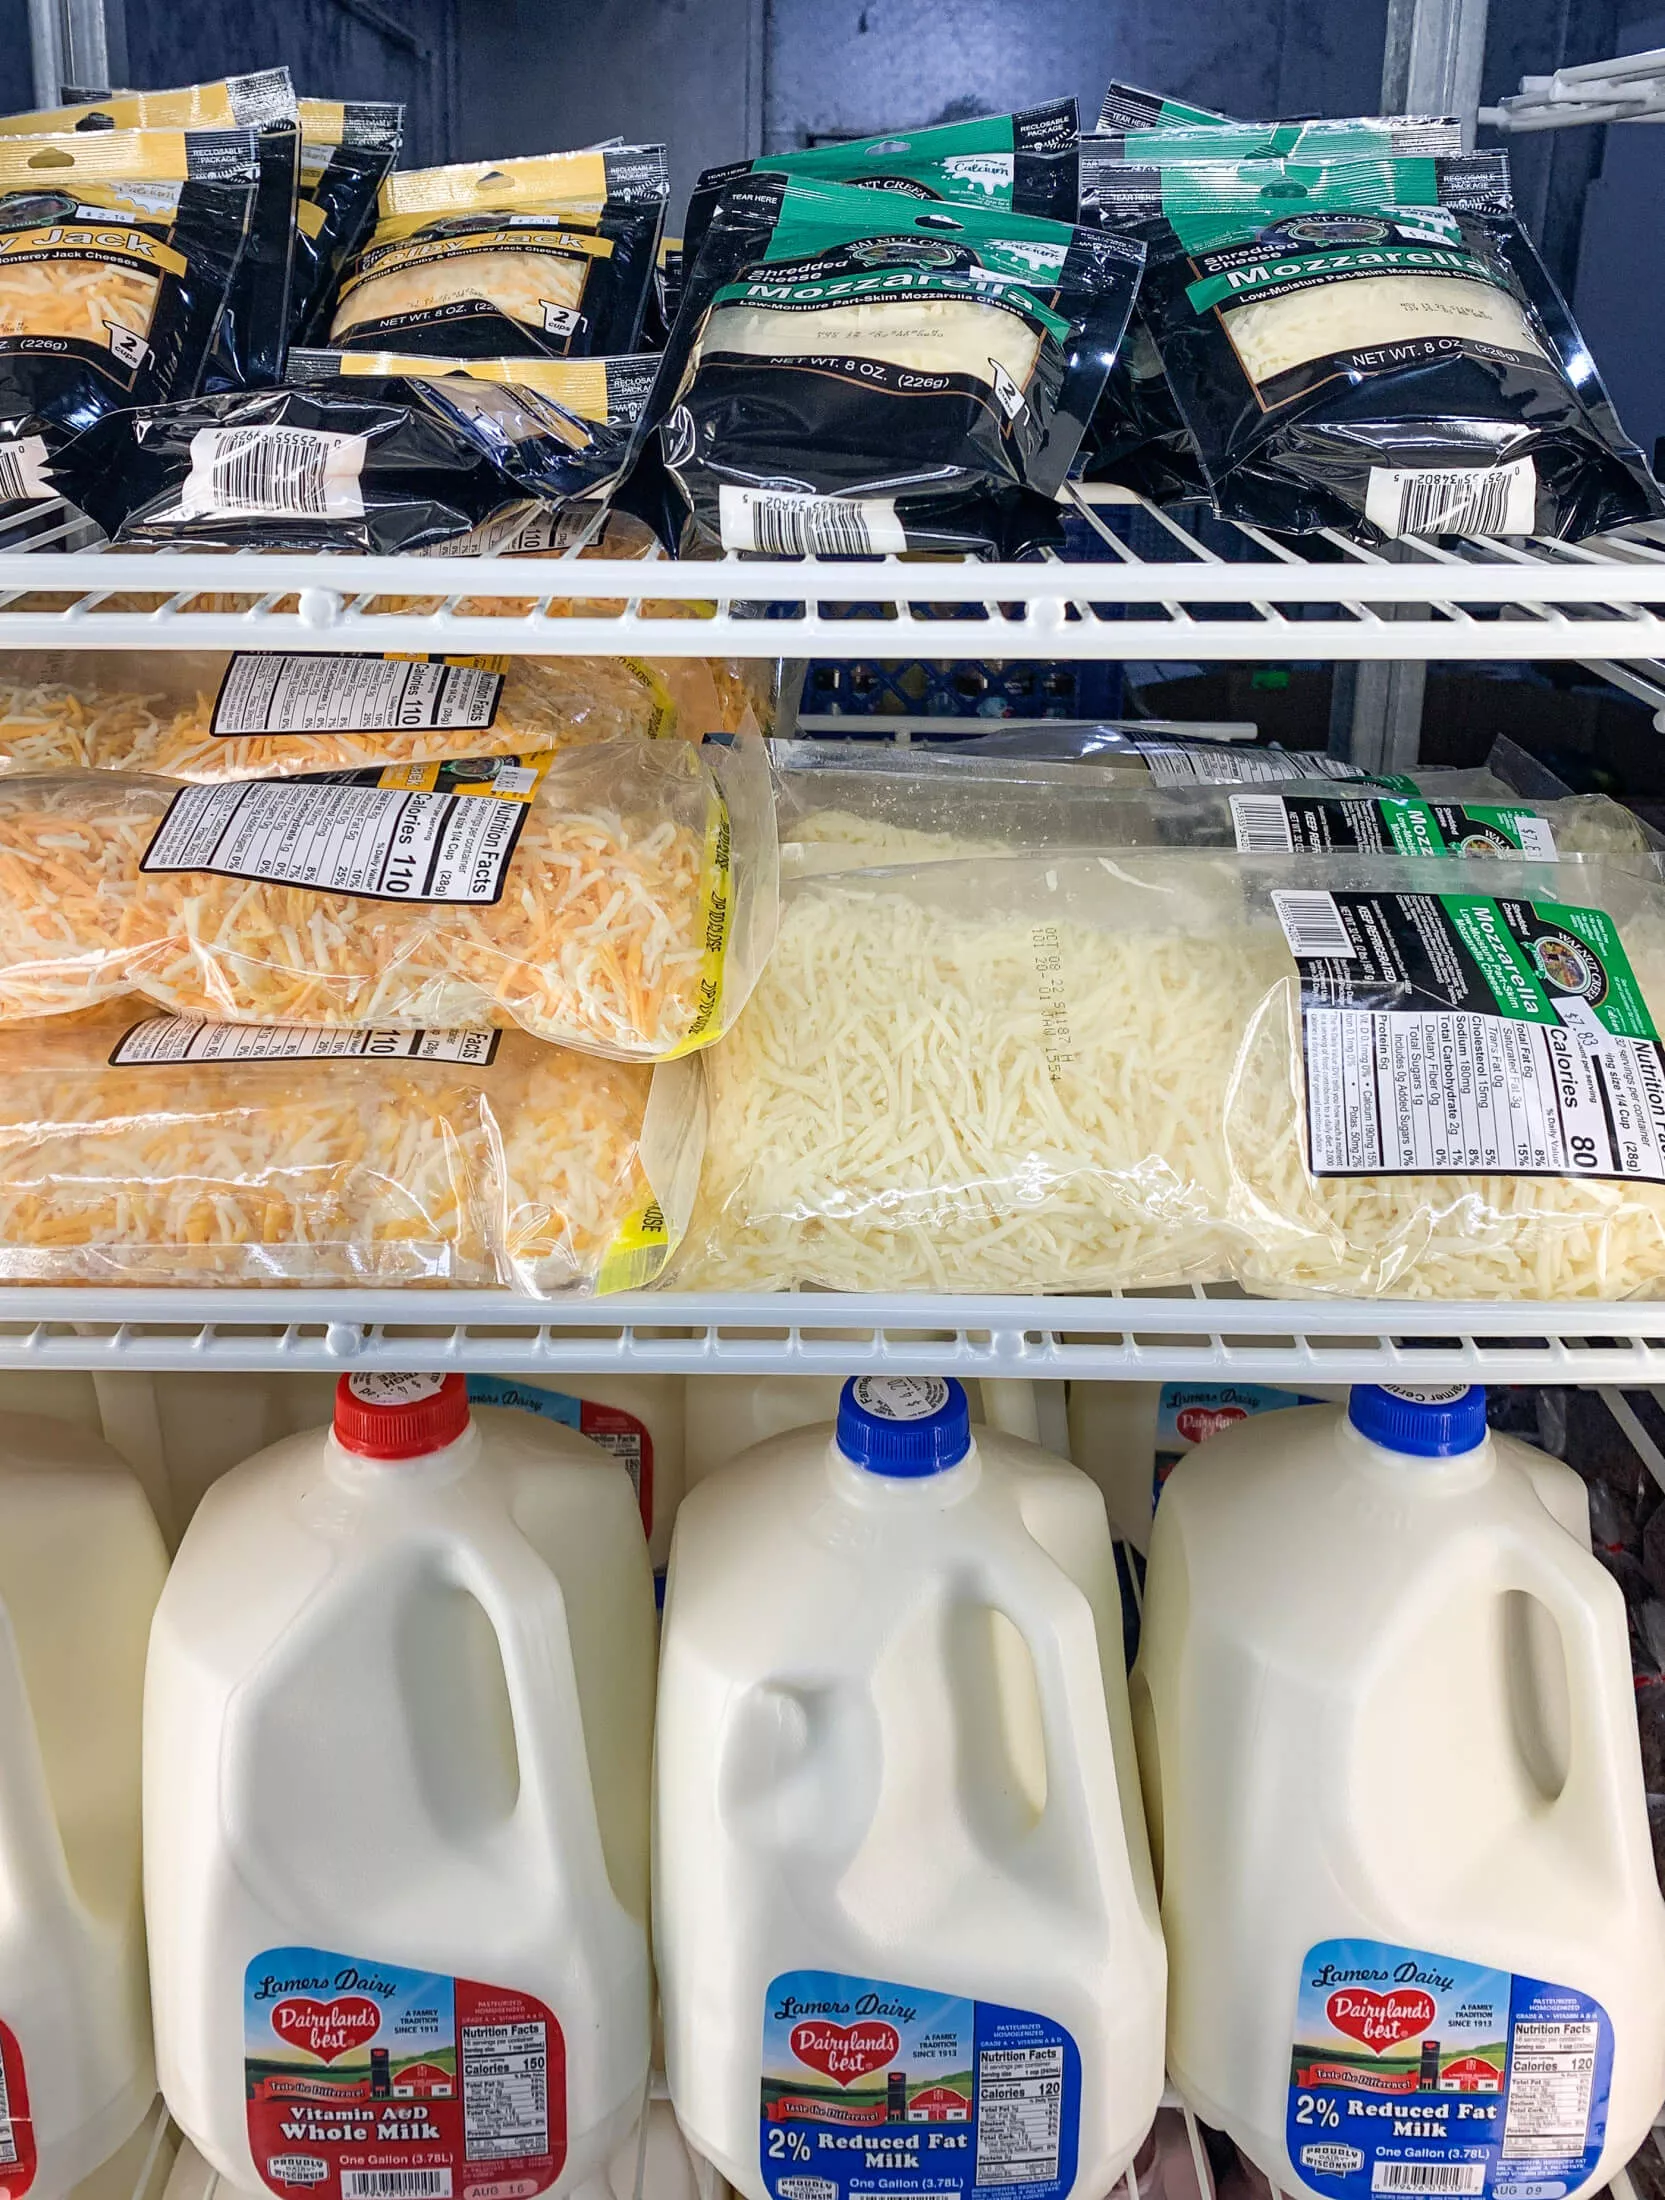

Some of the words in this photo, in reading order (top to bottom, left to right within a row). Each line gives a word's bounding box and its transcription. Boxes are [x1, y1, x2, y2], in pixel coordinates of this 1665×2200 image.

[1020, 115, 1070, 133] RECLOSABLE
[1027, 124, 1064, 137] PACKAGE
[954, 162, 1009, 177] Calcium
[732, 193, 753, 202] TEAR
[755, 195, 778, 204] HERE
[883, 180, 931, 199] CREEK
[32, 229, 157, 257] Jack
[482, 232, 585, 248] Jack
[85, 252, 138, 267] Cheeses
[404, 255, 433, 268] Colby
[446, 246, 495, 258] Monterey
[525, 246, 569, 257] Cheeses
[1204, 242, 1299, 266] Shredded
[1208, 252, 1282, 272] Cheese
[747, 272, 821, 284] Cheese
[751, 260, 848, 278] Shredded
[1226, 251, 1488, 289] Mozzarella
[746, 271, 1034, 311] Mozzarella
[1239, 277, 1325, 303] Low-Moisture
[1326, 267, 1386, 282] Part-Skim
[379, 317, 406, 328] NET
[409, 311, 430, 323] WT.
[435, 309, 443, 317] 8
[446, 304, 467, 315] OZ.
[739, 299, 829, 311] Low-Moisture
[832, 293, 897, 307] Part-Skim
[901, 292, 973, 301] Mozzarella
[976, 295, 1024, 317] Cheese
[548, 322, 572, 332] cups
[553, 311, 569, 323] 2
[20, 339, 68, 351] (226g)
[115, 346, 138, 364] cups
[120, 336, 138, 352] 2
[1352, 347, 1386, 367] NET
[1389, 345, 1421, 361] WT.
[1424, 343, 1435, 353] 8
[1438, 339, 1468, 350] OZ.
[770, 356, 806, 364] NET
[810, 357, 839, 368] WT.
[845, 360, 855, 371] 8
[860, 363, 887, 381] OZ.
[898, 374, 950, 389] (226g)
[1418, 475, 1458, 484] 34802
[408, 663, 429, 696] Calories
[402, 700, 423, 725] 110
[470, 701, 489, 721] Facts
[399, 793, 432, 844] Calories
[484, 802, 519, 848] Nutrition
[1304, 810, 1317, 833] KEEP
[443, 843, 459, 860] Cup
[459, 834, 474, 874] container
[289, 865, 301, 878] 7%
[304, 867, 317, 881] 8%
[334, 867, 348, 886] 25%
[350, 870, 362, 888] 10%
[387, 855, 416, 893] 110
[435, 871, 452, 896] (28g)
[472, 851, 499, 894] Facts
[712, 892, 726, 909] ZIP
[1357, 905, 1374, 927] KEEP
[706, 922, 723, 952] CLOSE
[1365, 925, 1397, 982] REFRIGERATED
[1456, 918, 1485, 961] Mozzarella
[1481, 962, 1503, 997] Cheese
[1459, 908, 1495, 963] Low-Moisture
[1492, 964, 1519, 1009] Part-Skim
[1472, 907, 1539, 1013] Mozzarella
[1558, 931, 1600, 973] WALNUT
[1584, 972, 1602, 1001] CREEK
[701, 978, 717, 998] ZIP
[1378, 1015, 1388, 1054] Protein
[1410, 1024, 1419, 1051] Total
[1441, 1016, 1450, 1044] Total
[1456, 1015, 1467, 1056] Sodium
[1515, 1023, 1527, 1048] Total
[461, 1031, 488, 1059] Facts
[1394, 1034, 1406, 1069] Includes
[1425, 1024, 1435, 1061] Dietary
[1472, 1016, 1485, 1077] Cholesterol
[1410, 1053, 1422, 1090] Sugars
[1429, 1064, 1439, 1090] Fiber
[1443, 1045, 1457, 1119] Carbohydrate
[1461, 1060, 1472, 1094] 180mg
[1632, 1041, 1665, 1116] Nutrition
[1399, 1085, 1408, 1112] Added
[1478, 1079, 1489, 1109] 15mg
[1503, 1028, 1518, 1075] Saturated
[1517, 1143, 1529, 1166] 15%
[1551, 1028, 1578, 1108] Calories
[1571, 1136, 1598, 1168] 80
[1399, 1114, 1410, 1145] Sugars
[1634, 1104, 1651, 1147] container
[1468, 1149, 1479, 1166] 8%
[1623, 1140, 1641, 1172] (28g)
[254, 1975, 329, 2000] Lamers
[334, 1968, 398, 1998] Dairy
[1312, 1964, 1388, 1987] Lamers
[1393, 1962, 1455, 1992] Dairy
[279, 2006, 375, 2030] Dairyland's
[774, 1996, 850, 2019] Lamers
[855, 1993, 918, 2023] Dairy
[1335, 1997, 1431, 2024] Dairyland's
[310, 2029, 347, 2049] best
[464, 2026, 508, 2038] Nutrition
[512, 2024, 539, 2035] Facts
[1363, 2019, 1401, 2039] best
[1516, 2025, 1560, 2036] Nutrition
[1563, 2023, 1591, 2034] Facts
[798, 2029, 895, 2056] Dairyland's
[465, 2064, 510, 2074] Calories
[523, 2057, 545, 2070] 150
[828, 2050, 865, 2071] best
[980, 2051, 1025, 2062] Nutrition
[1029, 2049, 1056, 2060] Facts
[1513, 2061, 1558, 2071] Calories
[1572, 2058, 1592, 2071] 120
[980, 2089, 1025, 2099] Calories
[1039, 2083, 1060, 2095] 120
[290, 2106, 374, 2121] Vitamin
[1296, 2095, 1339, 2127] 2%
[1347, 2100, 1449, 2118] Reduced
[1457, 2104, 1497, 2119] Fat
[281, 2123, 368, 2140] Whole
[377, 2123, 440, 2139] Milk
[1392, 2121, 1448, 2137] Milk
[768, 2128, 811, 2161] 2%
[818, 2133, 919, 2149] Reduced
[928, 2133, 968, 2149] Fat
[1405, 2147, 1445, 2158] Gallon
[1448, 2148, 1490, 2160] (3.78L)
[368, 2155, 408, 2165] Gallon
[865, 2152, 919, 2168] Milk
[1306, 2157, 1357, 2168] WISCONSIN
[472, 2185, 498, 2197] AUG
[878, 2178, 918, 2188] Gallon
[922, 2178, 963, 2189] (3.78L)
[1491, 2184, 1517, 2195] AUG
[1526, 2185, 1542, 2196] 09
